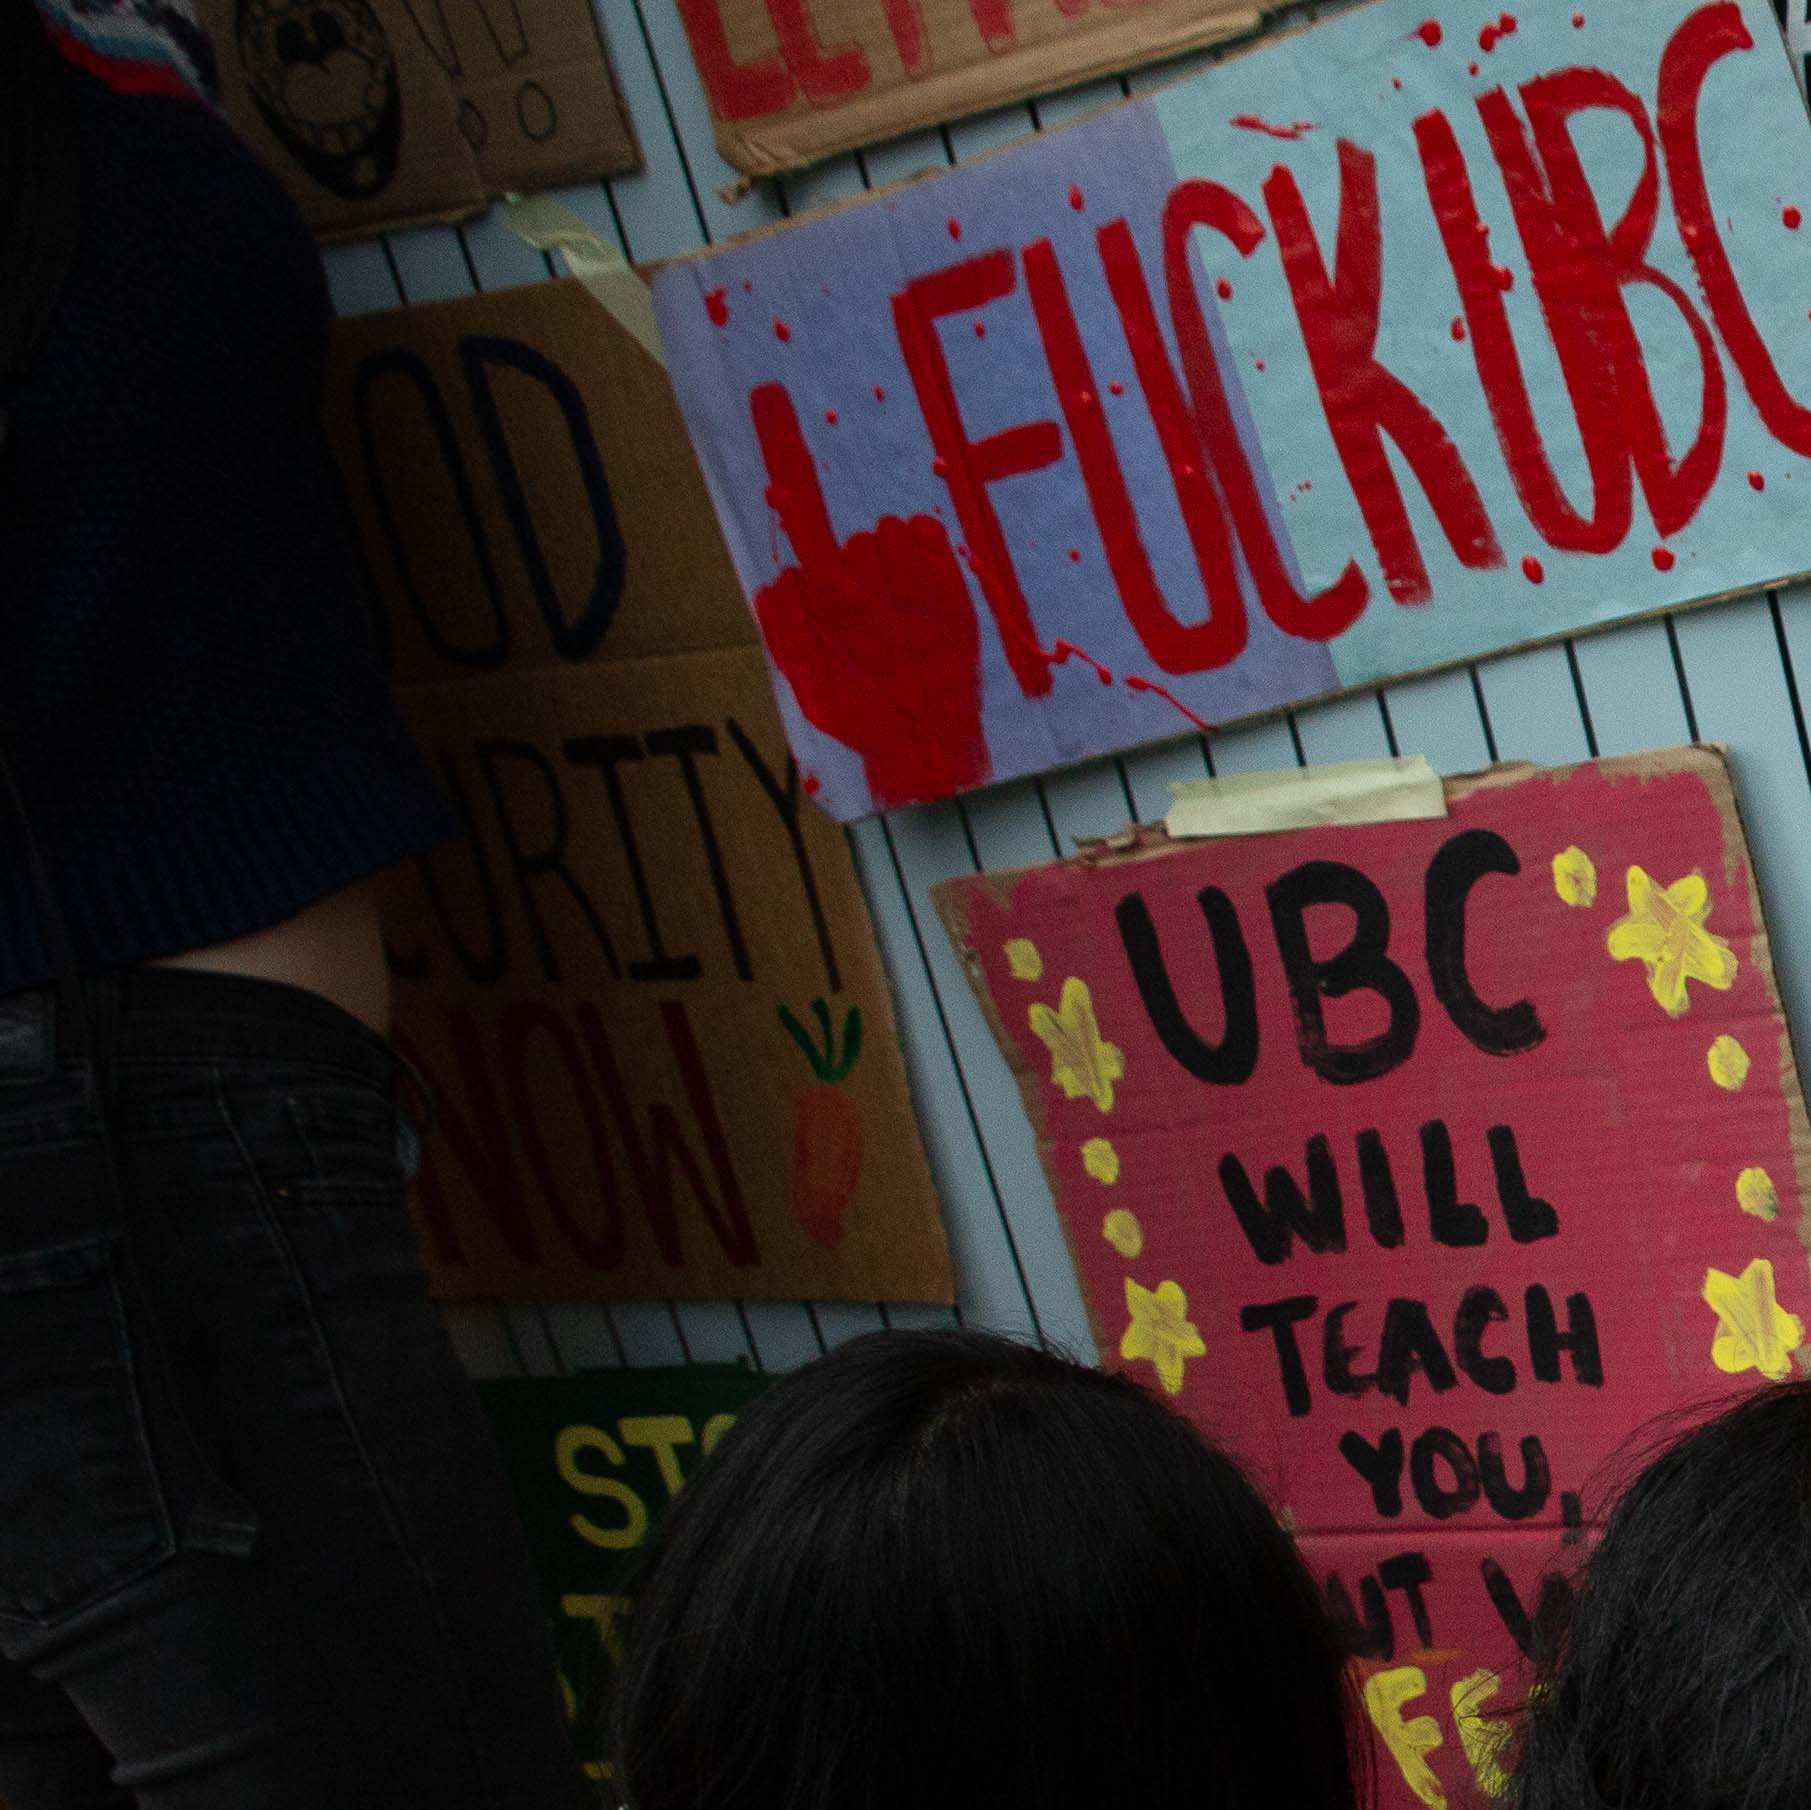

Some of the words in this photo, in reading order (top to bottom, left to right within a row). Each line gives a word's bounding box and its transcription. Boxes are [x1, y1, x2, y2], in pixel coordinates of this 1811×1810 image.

[890, 140, 1506, 700] FUCK
[1115, 828, 1548, 1086] UBC
[1218, 1119, 1560, 1264] WILL
[1241, 1282, 1605, 1417] TEACH
